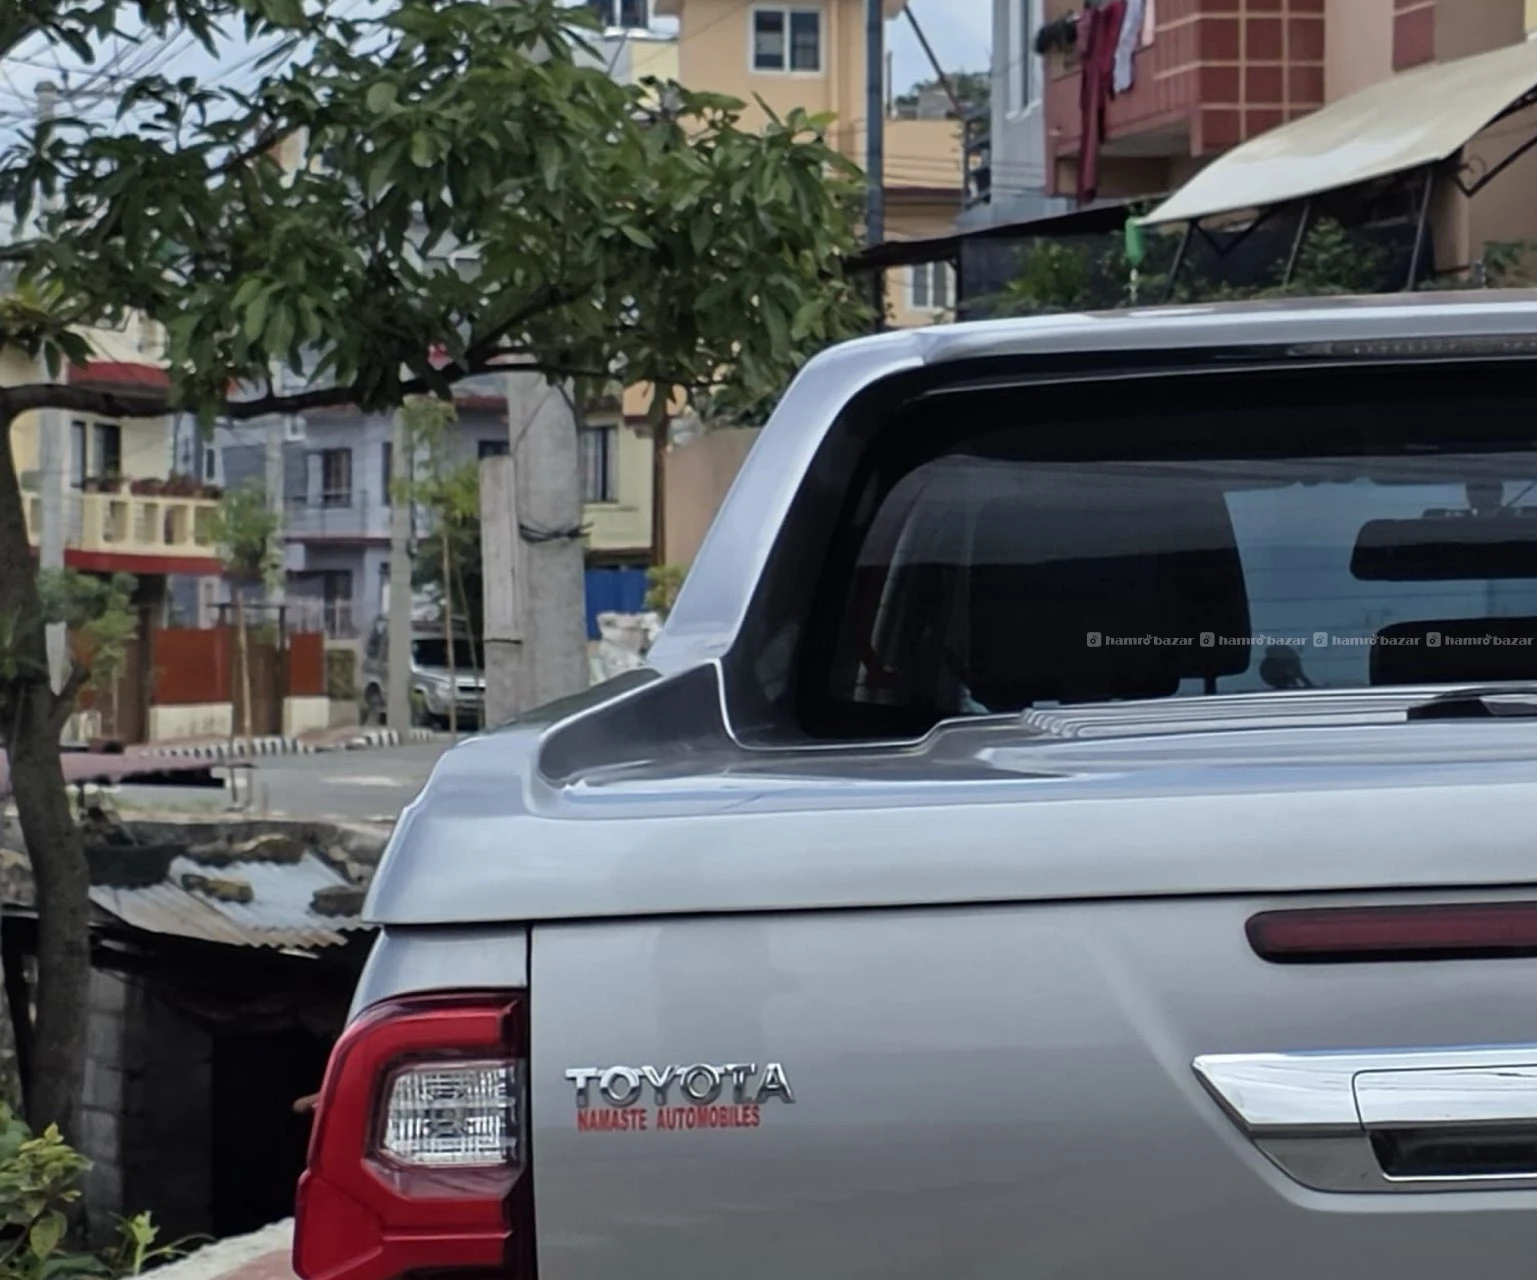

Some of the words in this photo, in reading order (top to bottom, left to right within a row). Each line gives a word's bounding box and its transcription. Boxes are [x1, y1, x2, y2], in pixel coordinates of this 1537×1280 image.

[565, 1062, 796, 1108] TOYOTA
[577, 1107, 648, 1132] NAMASTE
[655, 1105, 761, 1130] AUTOMOBILES
